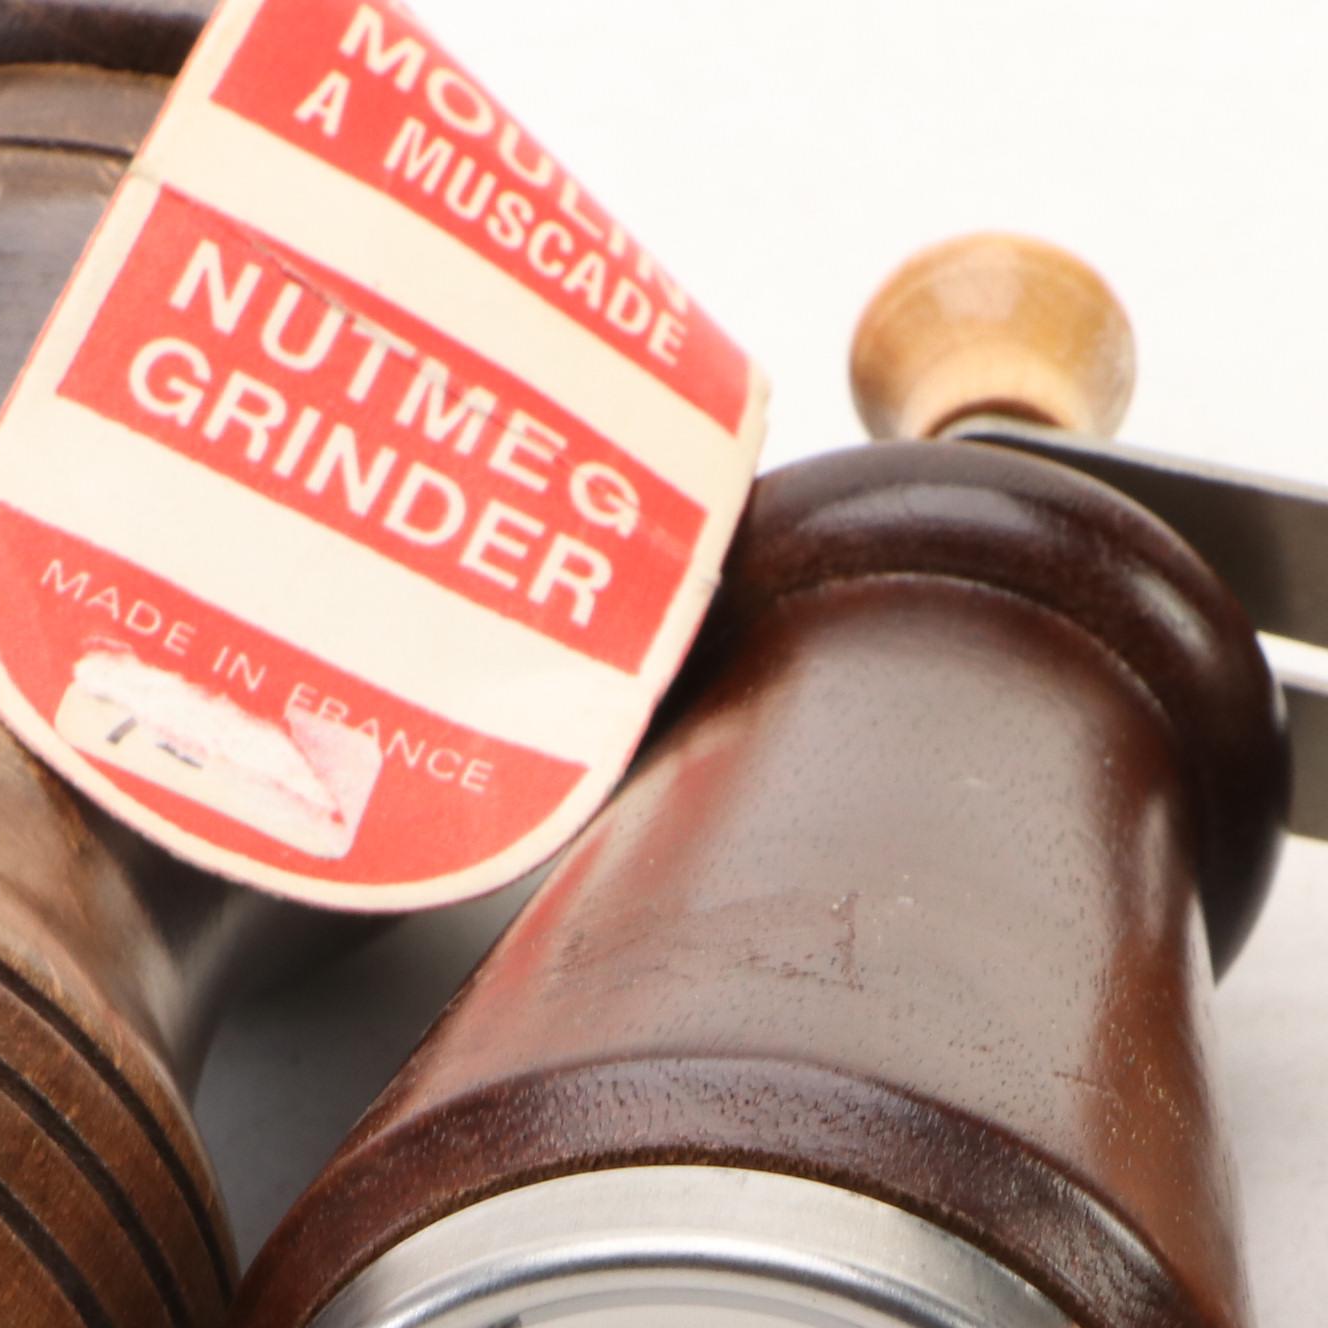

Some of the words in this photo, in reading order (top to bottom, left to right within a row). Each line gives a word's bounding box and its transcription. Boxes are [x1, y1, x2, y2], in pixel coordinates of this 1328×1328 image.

[294, 68, 351, 138] A
[383, 116, 688, 367] MUSCADE
[127, 337, 613, 629] GRINDER
[169, 238, 640, 539] NUTMEG
[40, 558, 197, 657] MADE
[210, 645, 267, 692] IN
[284, 682, 495, 793] FRANCE
